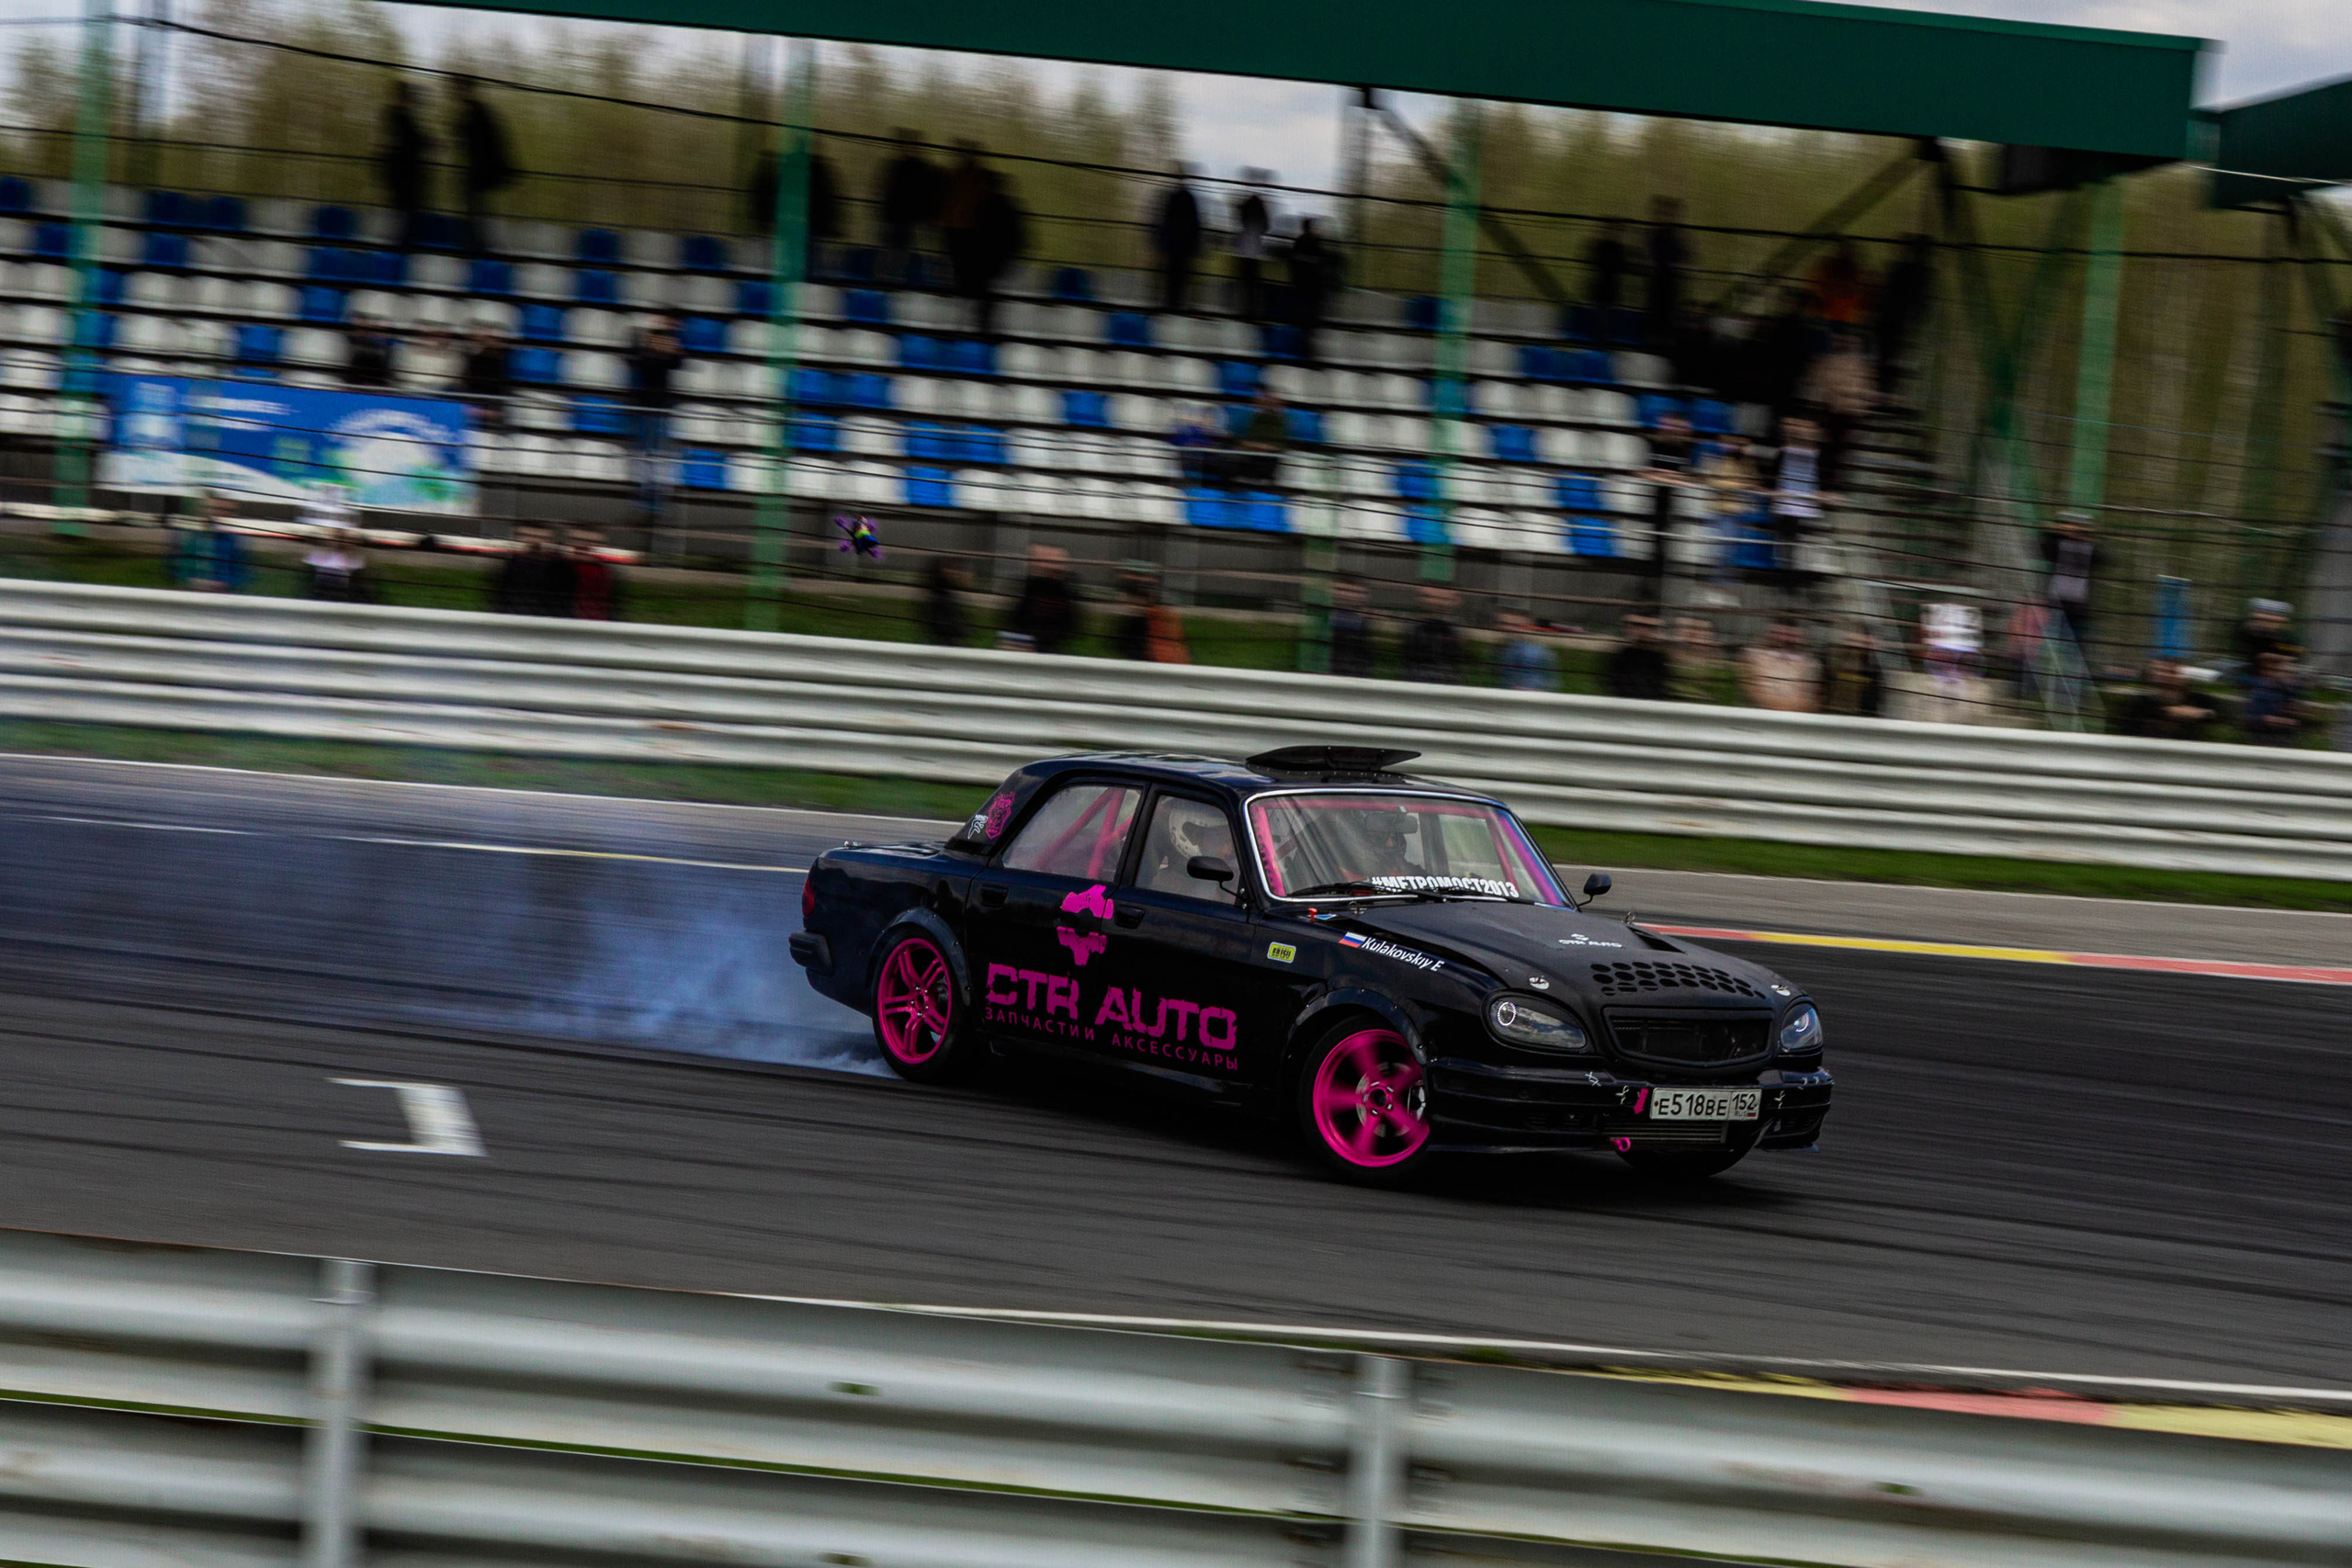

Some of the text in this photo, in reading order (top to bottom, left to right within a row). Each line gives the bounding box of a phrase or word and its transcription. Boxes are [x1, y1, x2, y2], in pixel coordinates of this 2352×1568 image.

[1362, 937, 1445, 972] Kulakovskiy E
[985, 963, 1238, 1050] CTR AUTO
[1112, 1032, 1238, 1071] АКСЕССУАРЫ
[1733, 1093, 1757, 1111] 152
